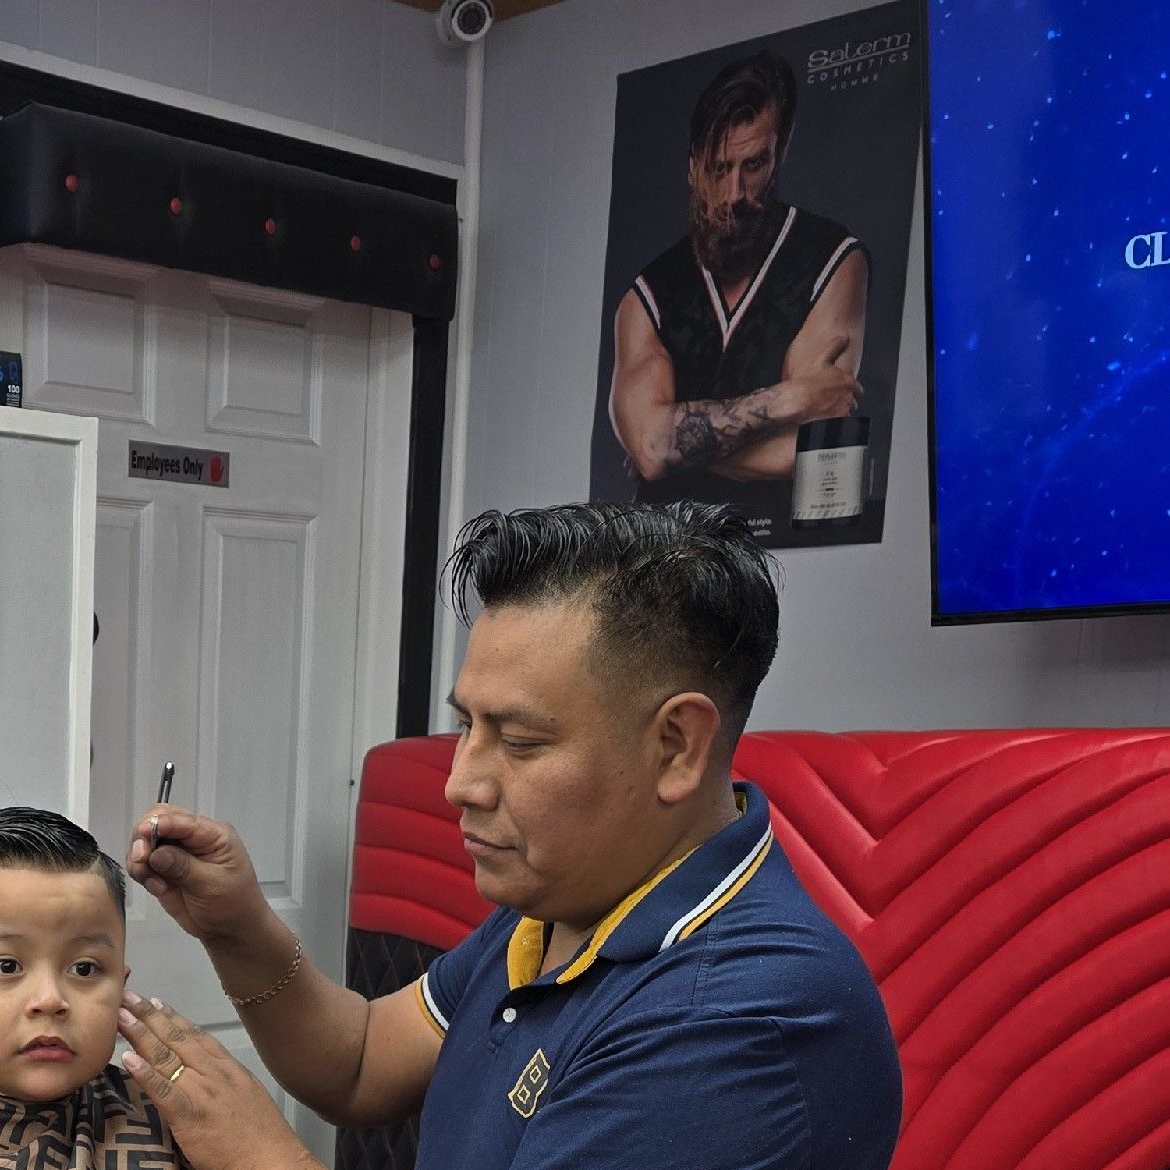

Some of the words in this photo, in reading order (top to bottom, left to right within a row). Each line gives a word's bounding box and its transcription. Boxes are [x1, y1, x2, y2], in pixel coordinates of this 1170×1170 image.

[807, 51, 909, 84] COSMETICS
[830, 73, 879, 91] HOMME
[7, 384, 20, 394] 100
[131, 449, 180, 477] Employees
[182, 455, 204, 481] Only
